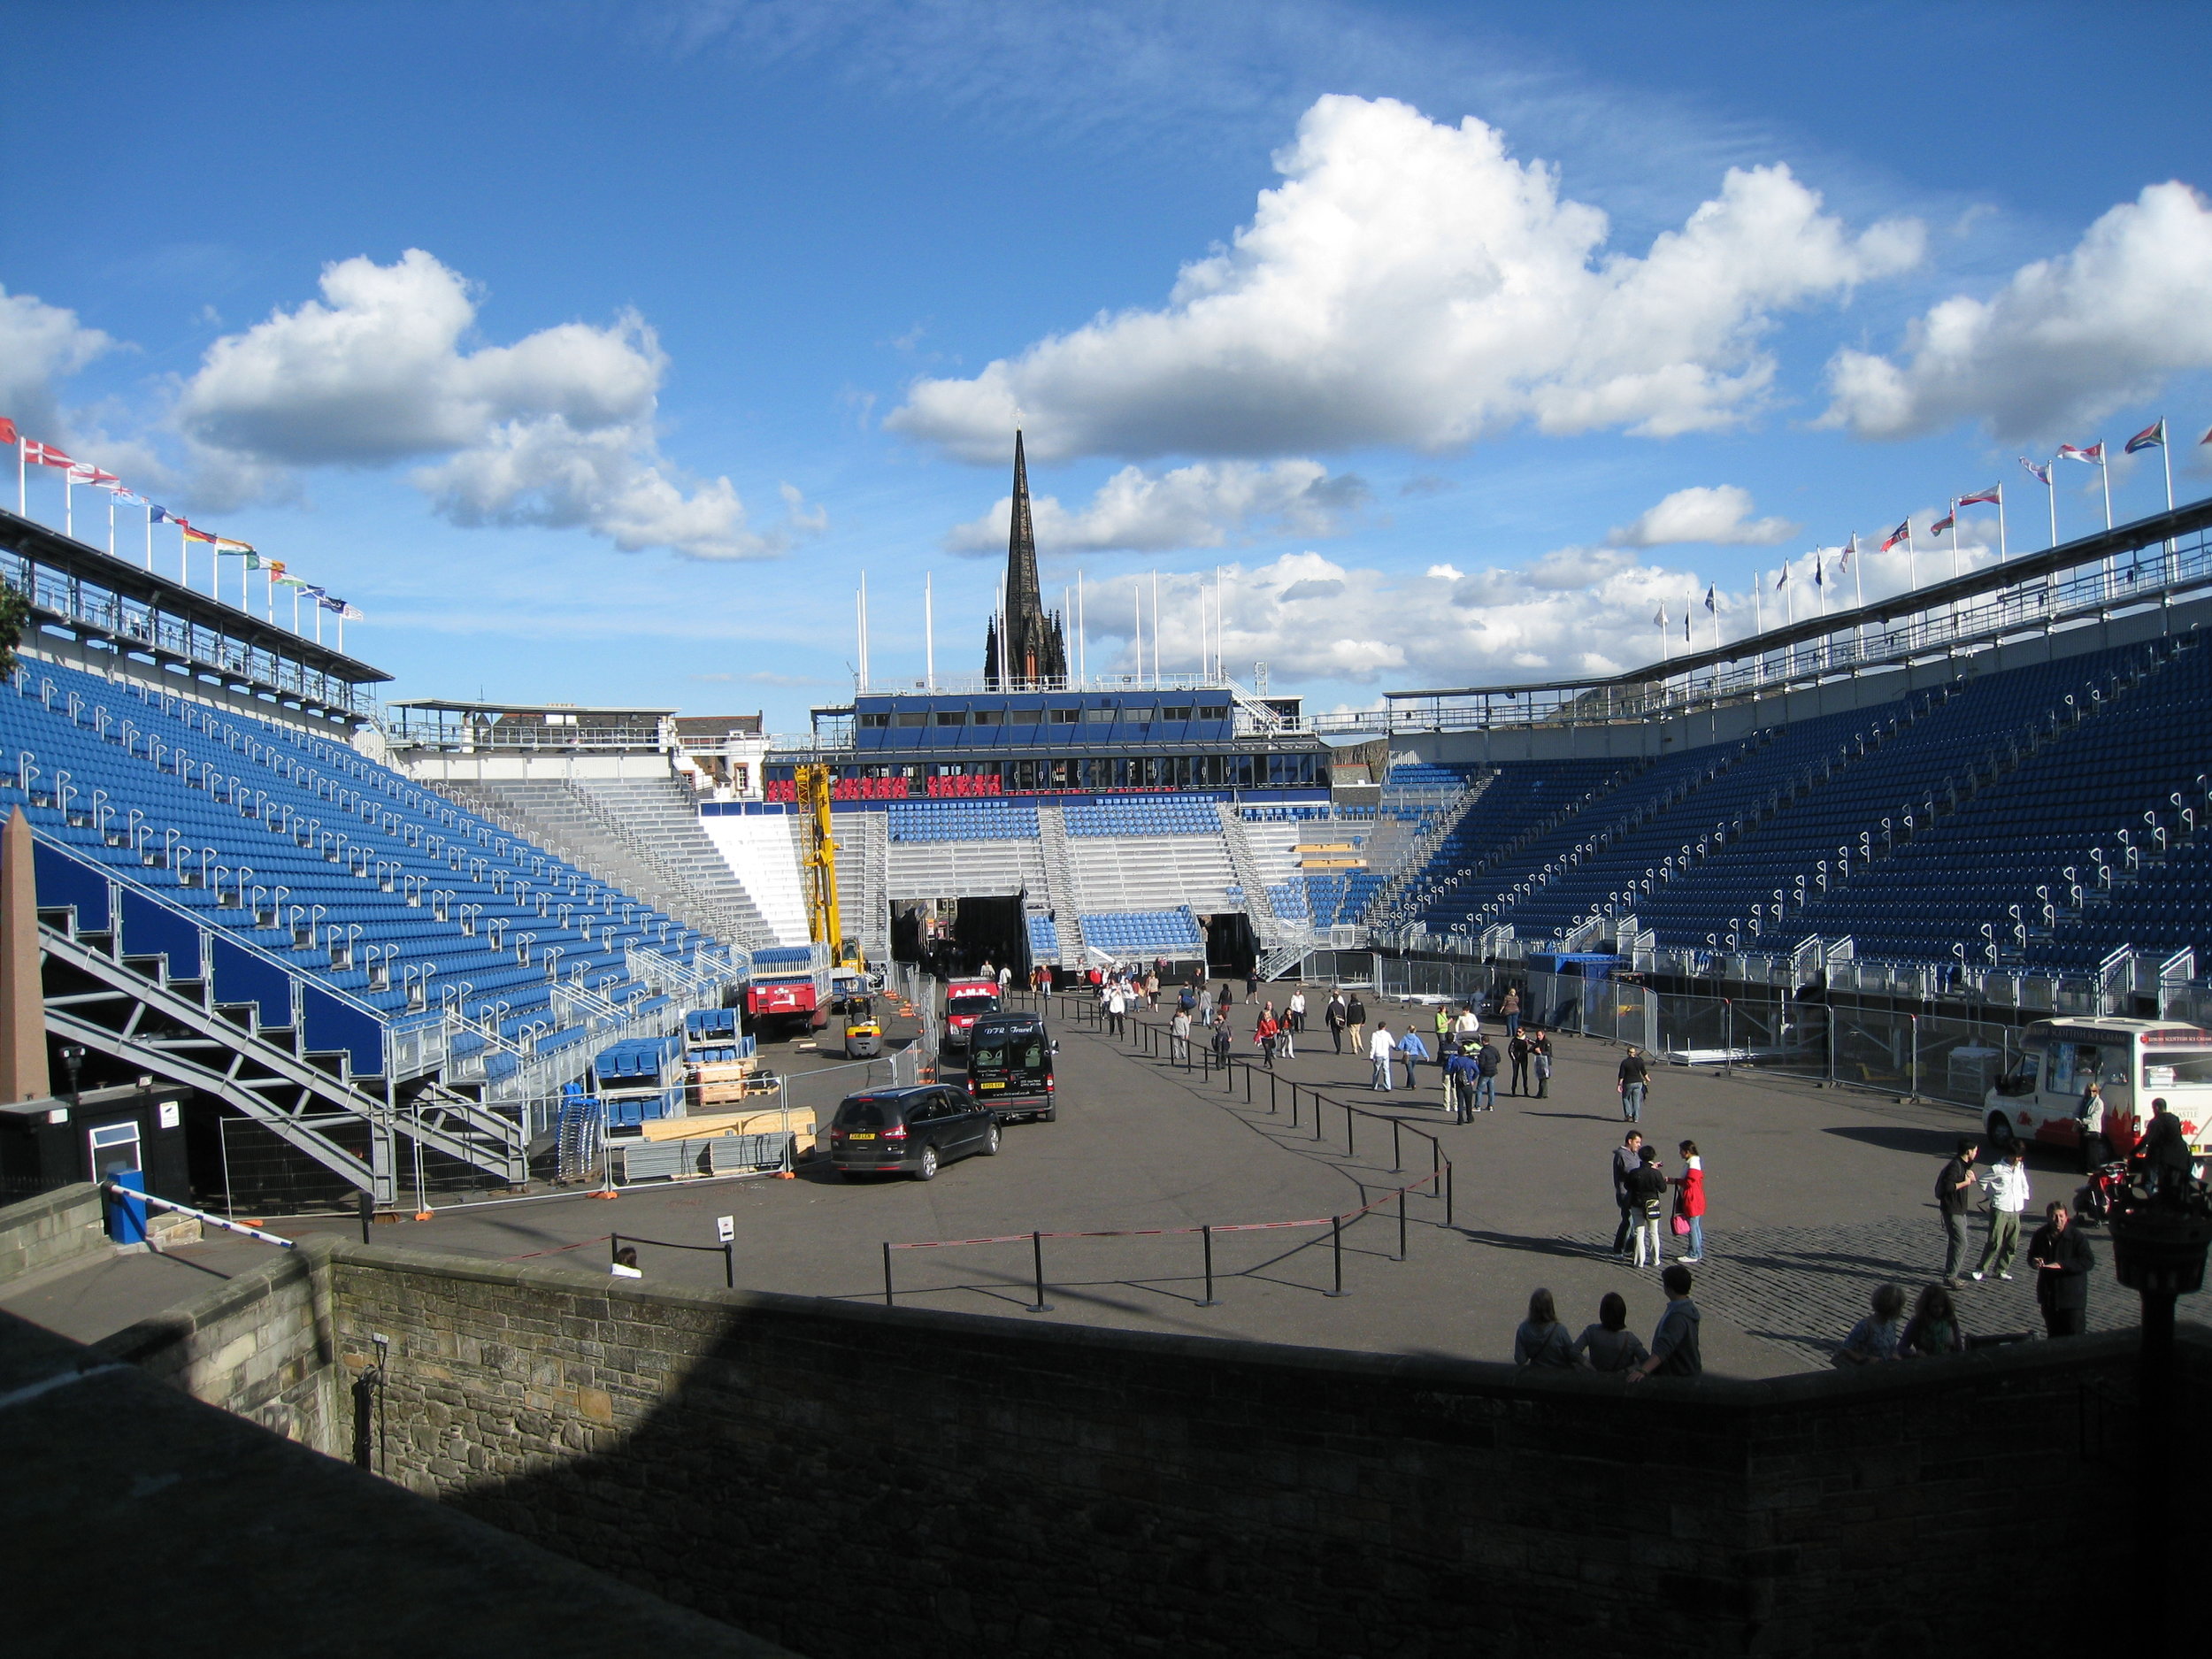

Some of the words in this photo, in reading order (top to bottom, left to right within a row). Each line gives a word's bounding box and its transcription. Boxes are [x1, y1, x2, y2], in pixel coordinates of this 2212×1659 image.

[956, 988, 990, 997] A.M.K.
[2052, 1028, 2085, 1039] SCOTTISH
[2088, 1030, 2098, 1041] ICE
[2101, 1033, 2125, 1042] CREAM
